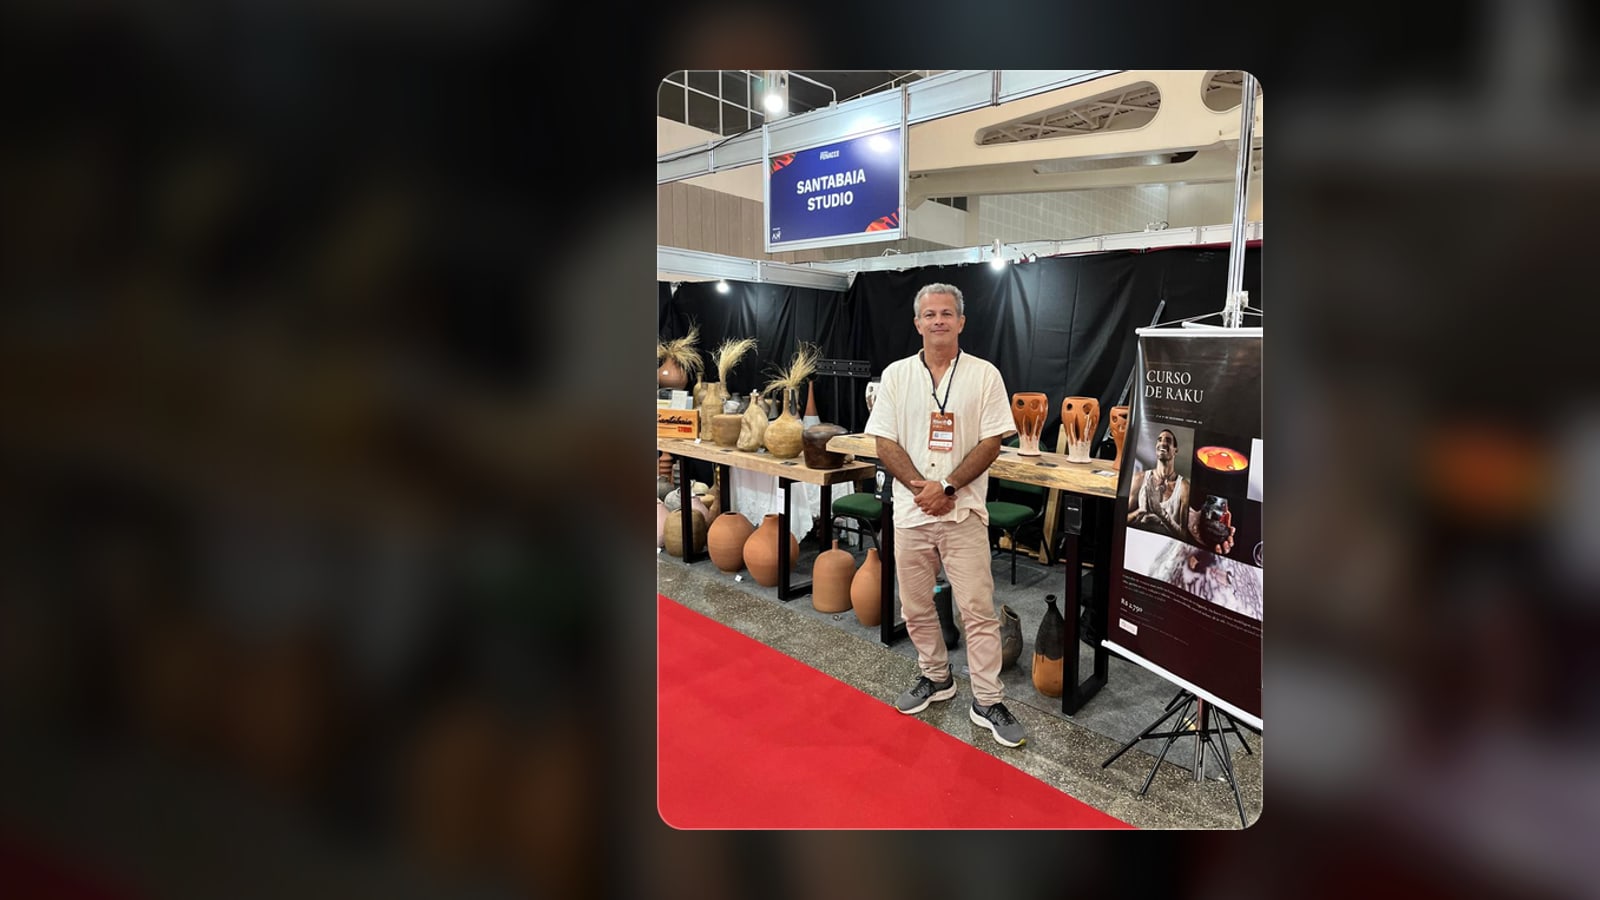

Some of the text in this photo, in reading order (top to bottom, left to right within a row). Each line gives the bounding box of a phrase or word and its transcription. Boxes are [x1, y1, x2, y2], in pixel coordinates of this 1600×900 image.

[797, 168, 866, 194] SANTABAIA
[807, 191, 854, 211] STUDIO
[1146, 370, 1191, 385] CURSO
[1144, 385, 1204, 403] DE RAKU
